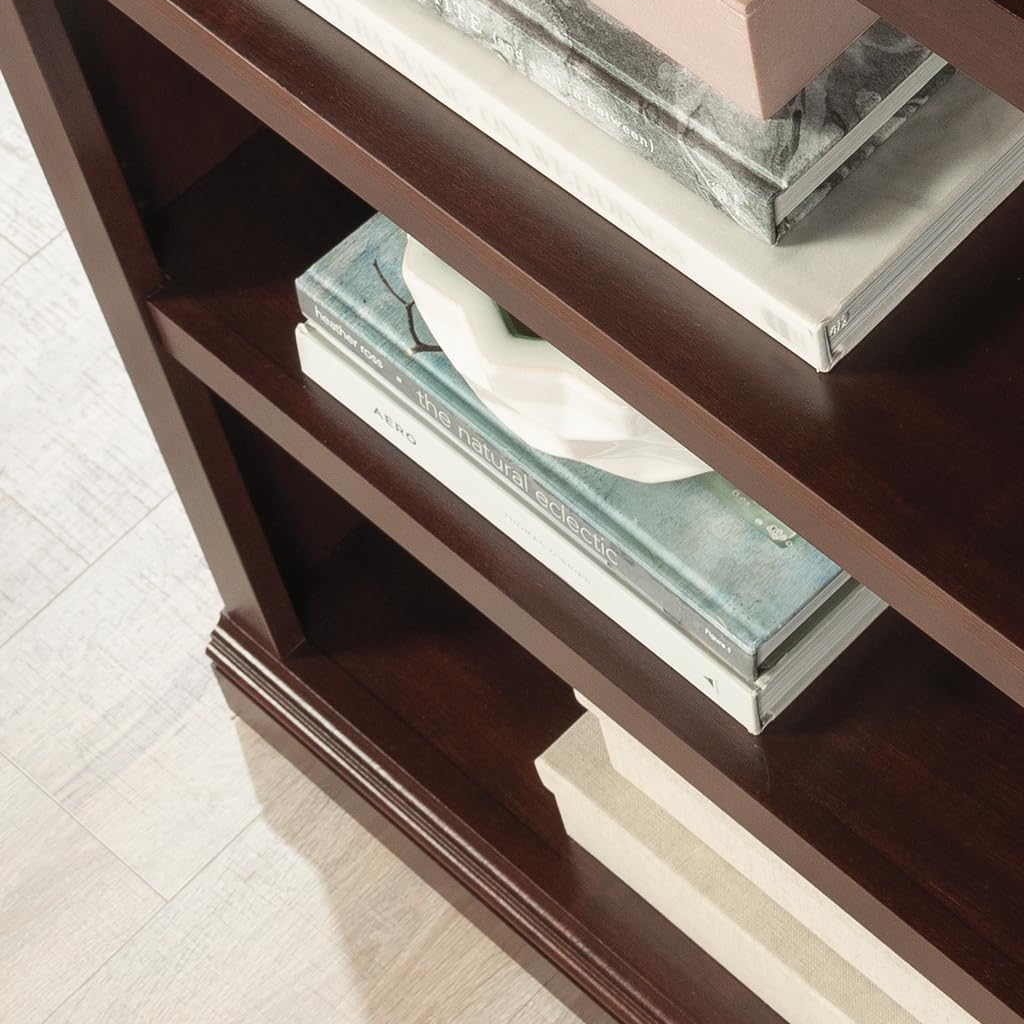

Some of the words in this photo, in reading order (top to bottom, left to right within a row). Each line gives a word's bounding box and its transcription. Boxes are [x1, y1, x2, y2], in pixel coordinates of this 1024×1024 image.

[586, 95, 655, 154] between)
[314, 305, 358, 348] heather
[359, 345, 384, 369] ross
[416, 389, 451, 426] the
[457, 426, 529, 493] natural
[535, 489, 619, 567] eclectic
[373, 406, 418, 447] AERO
